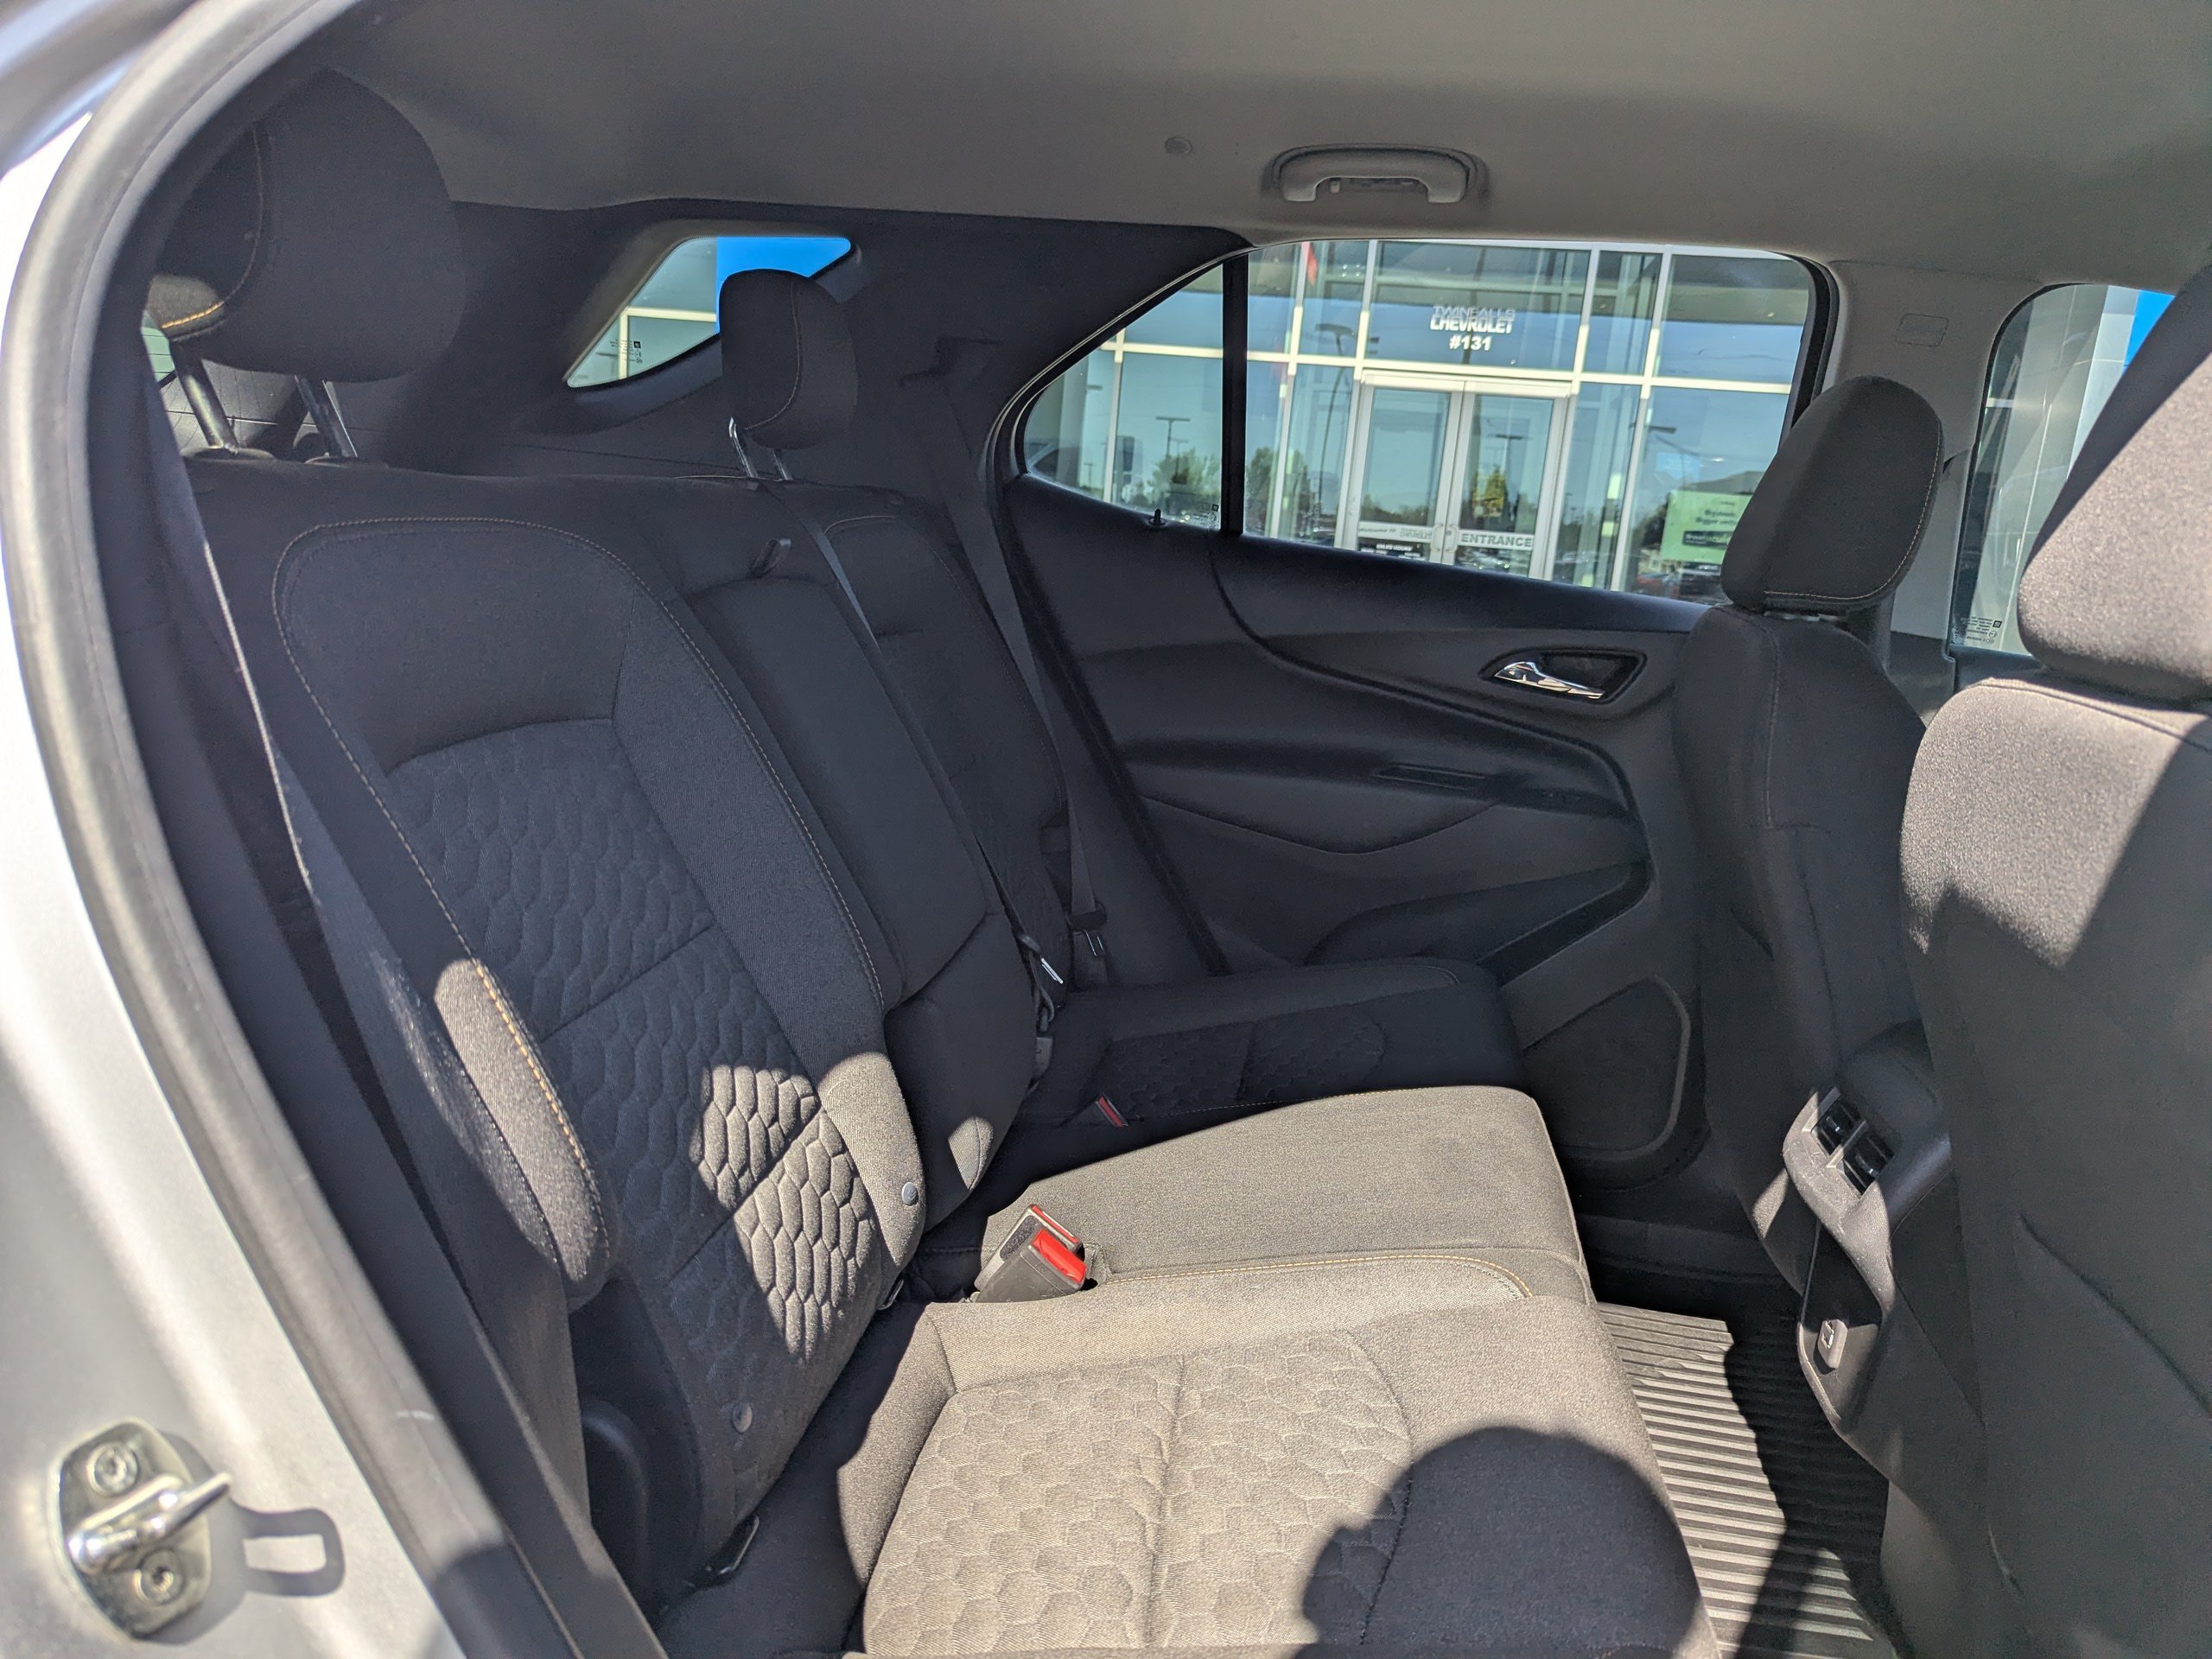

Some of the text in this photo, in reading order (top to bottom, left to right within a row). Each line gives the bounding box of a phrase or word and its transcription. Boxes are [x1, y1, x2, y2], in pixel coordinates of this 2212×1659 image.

[1430, 315, 1514, 334] CHEVROLET
[1449, 334, 1492, 351] #131
[1461, 532, 1533, 548] ENTRANCE
